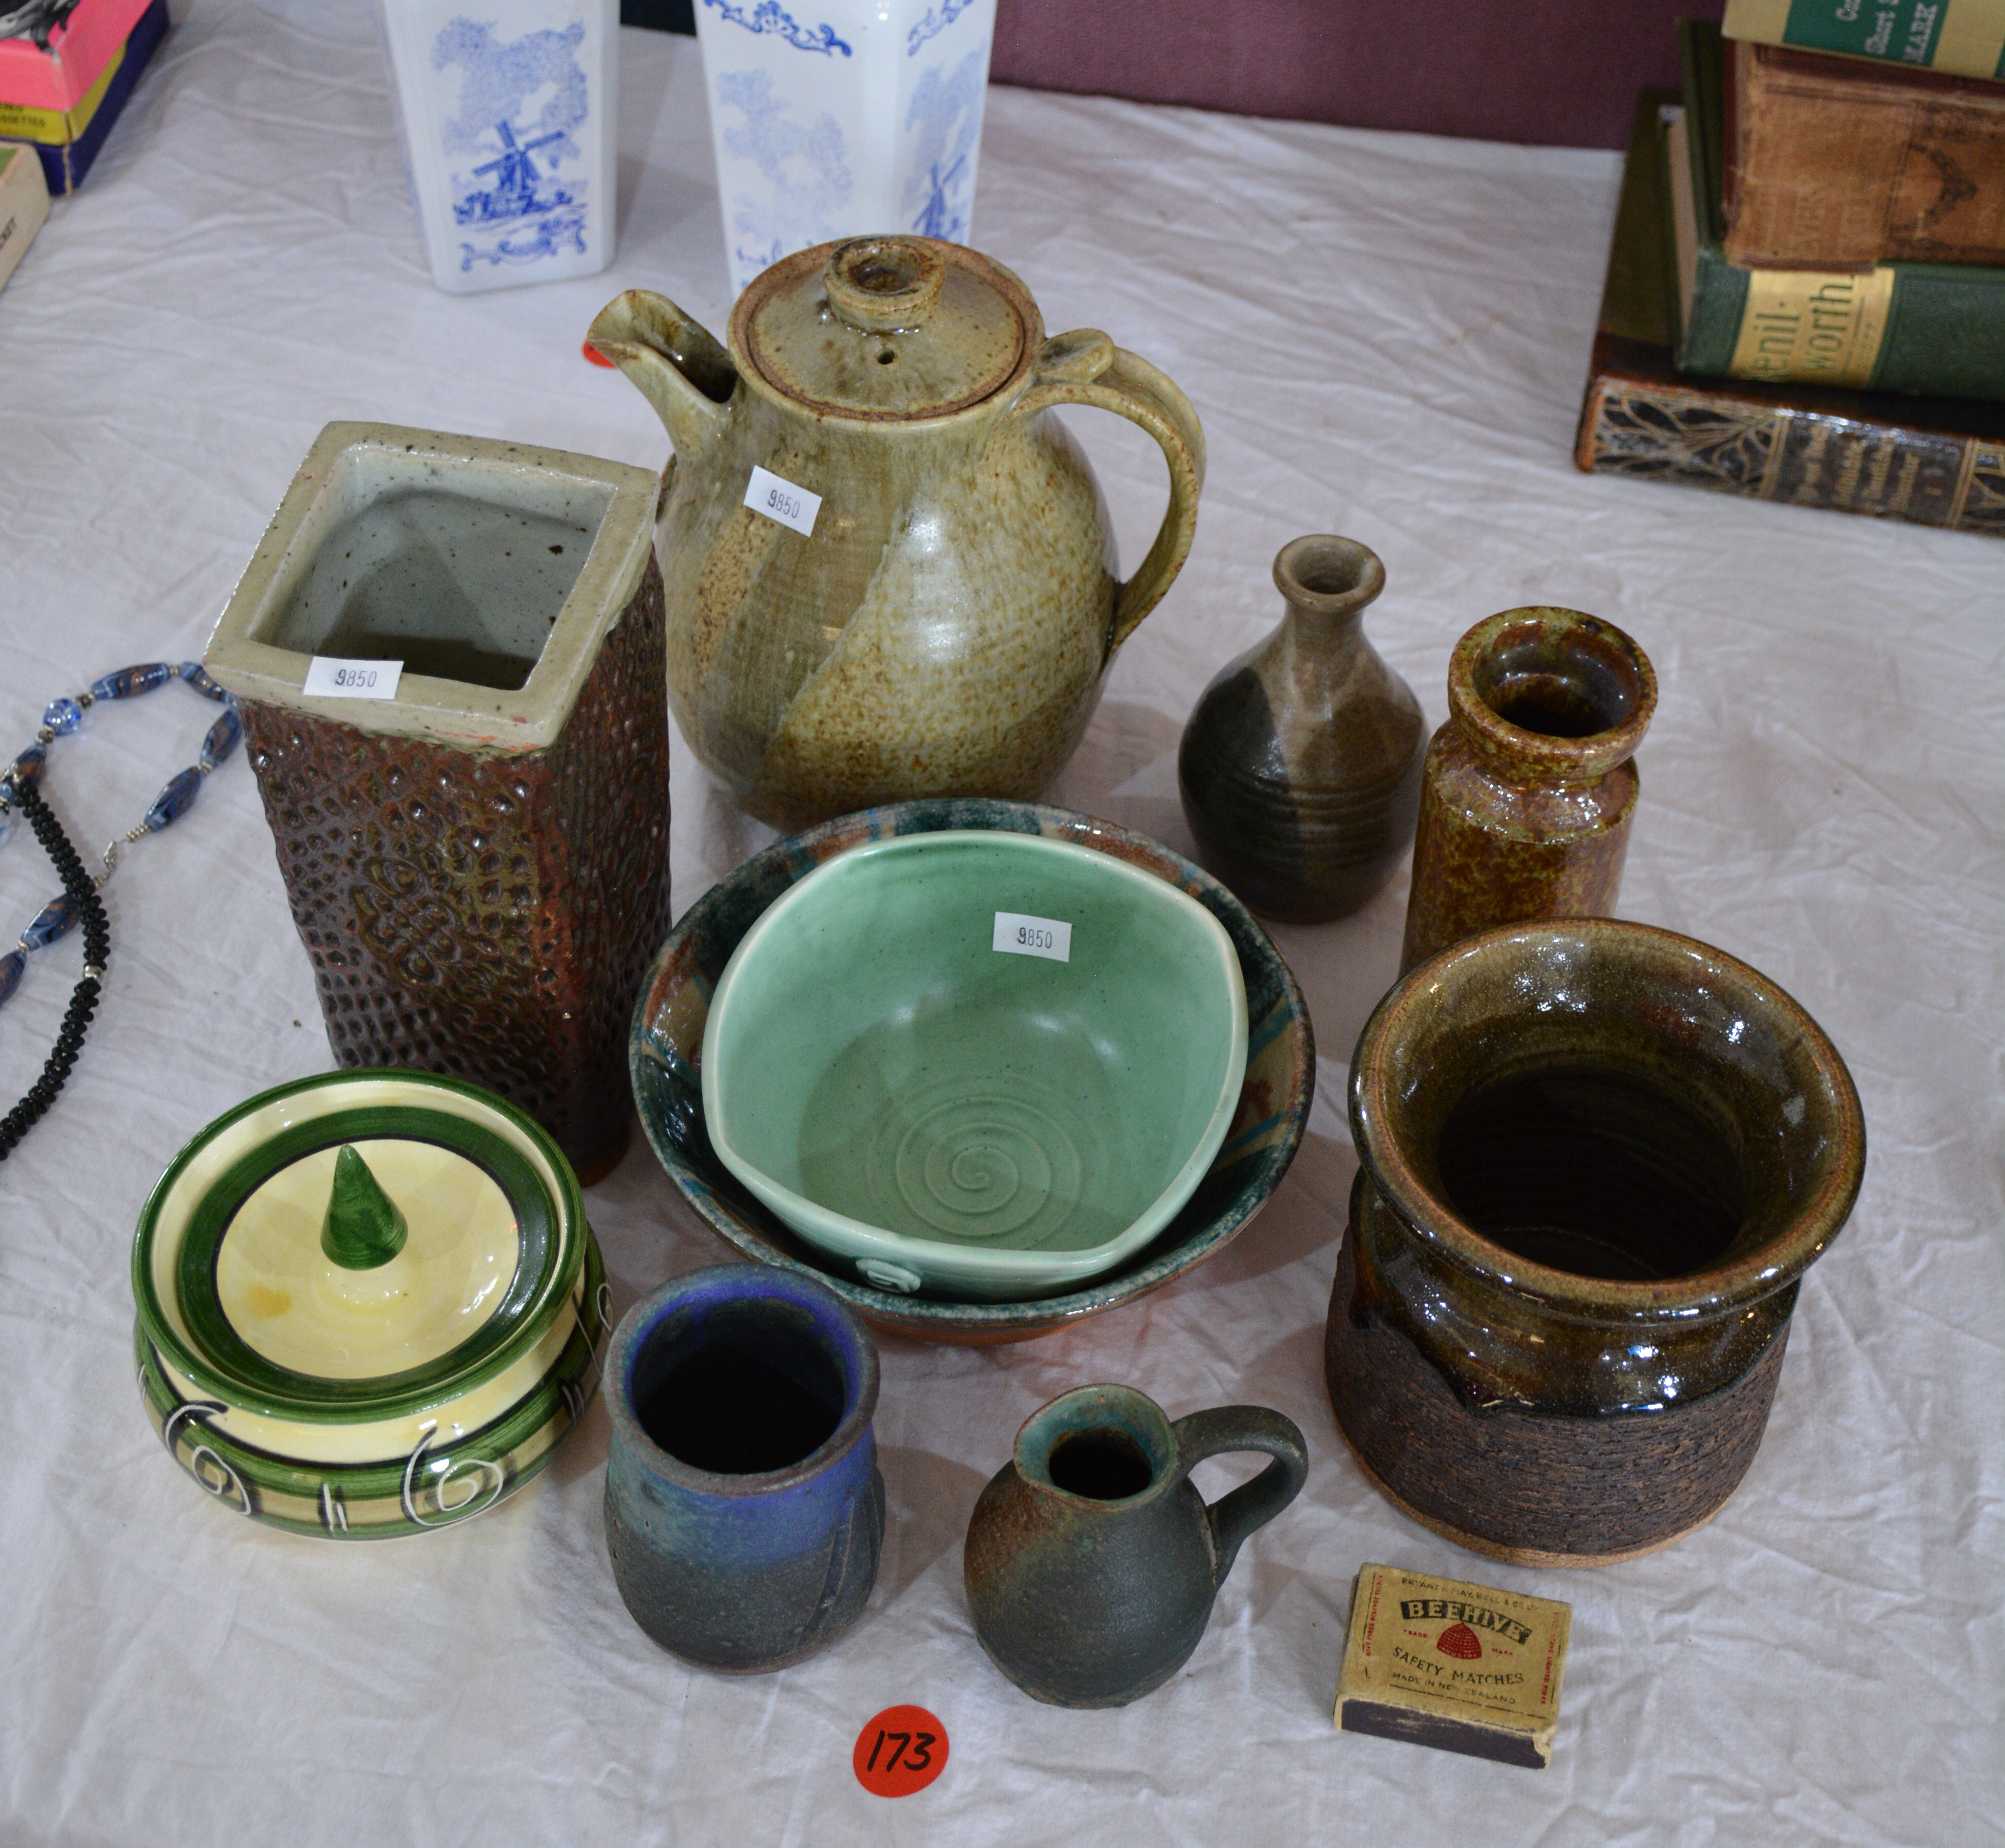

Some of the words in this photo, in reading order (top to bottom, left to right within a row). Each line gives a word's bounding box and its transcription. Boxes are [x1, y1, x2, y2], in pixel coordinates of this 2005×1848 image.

[768, 489, 800, 519] 9850
[335, 669, 377, 687] 9850
[1018, 927, 1052, 949] 9850
[1405, 1600, 1527, 1643] BEEHIVE
[1403, 1628, 1427, 1638] TRADE
[1491, 1647, 1513, 1656] MARK
[1393, 1647, 1444, 1676] SAFETY
[1452, 1670, 1524, 1685] MATCHES
[1544, 1656, 1552, 1682] LIGHTED
[1393, 1673, 1420, 1684] MADE
[1424, 1679, 1434, 1687] IN
[1439, 1682, 1458, 1691] NEW
[1464, 1688, 1516, 1704] ZEALAND
[1540, 1685, 1548, 1704] FIRES
[867, 1730, 936, 1772] 173
